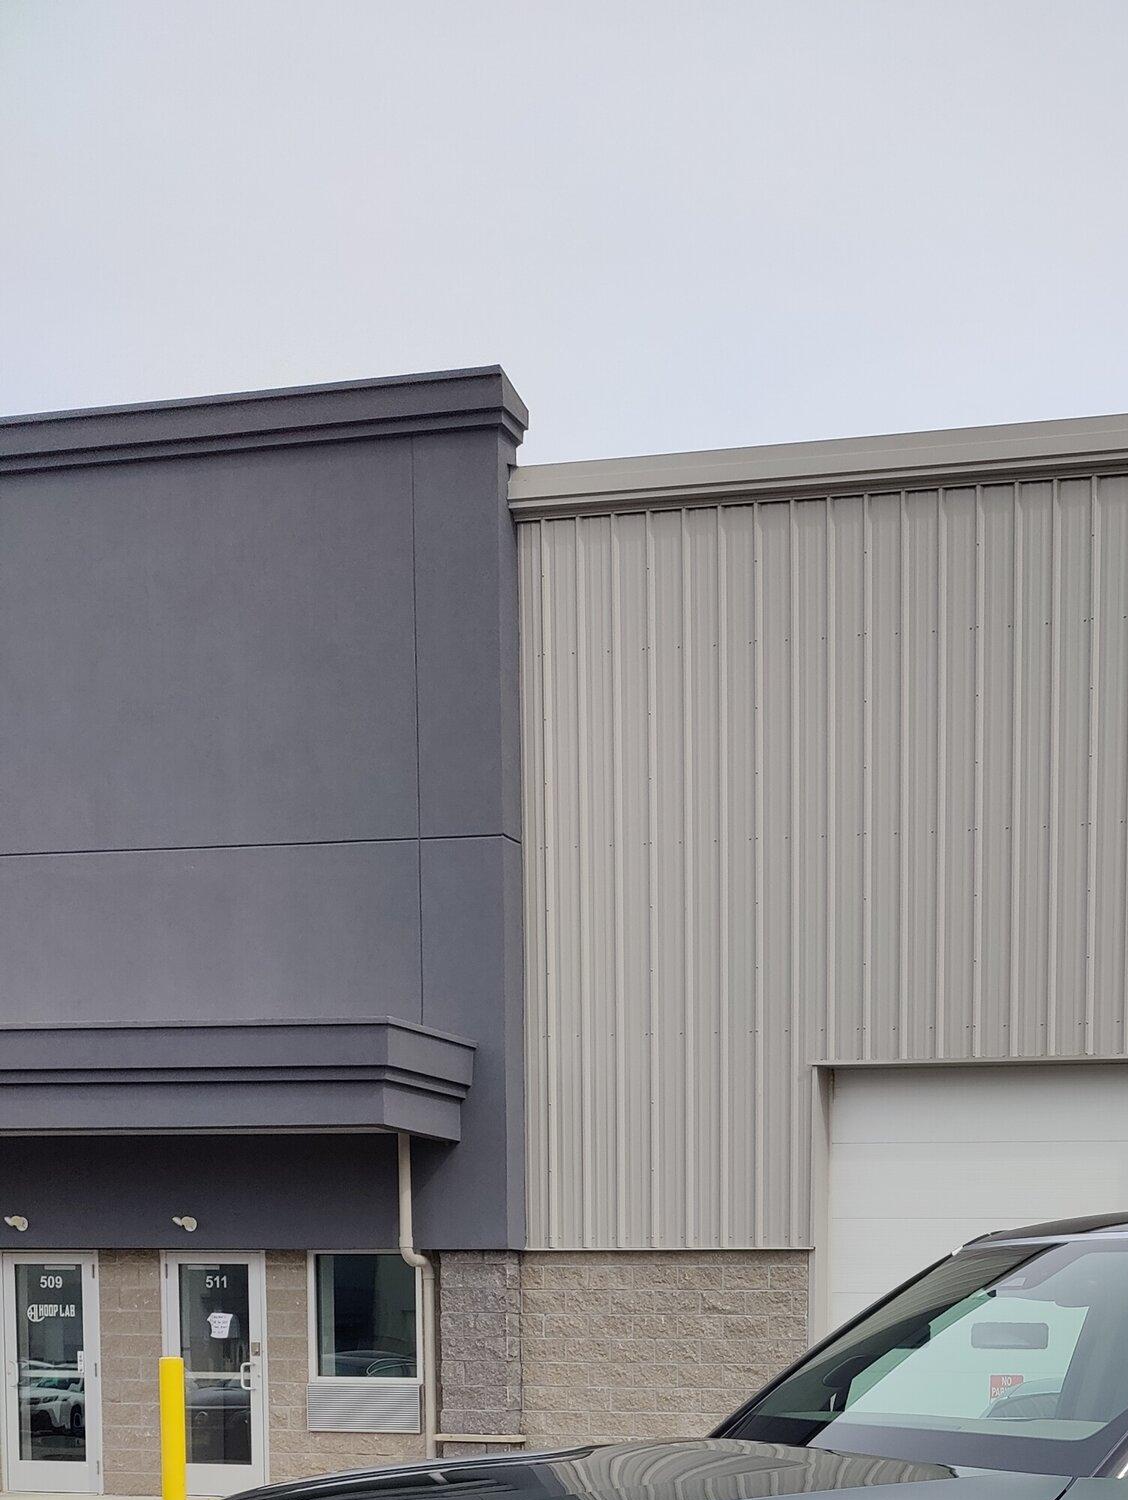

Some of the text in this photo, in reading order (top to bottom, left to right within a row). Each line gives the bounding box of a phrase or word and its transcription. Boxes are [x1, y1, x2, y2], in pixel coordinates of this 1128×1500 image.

[40, 1275, 63, 1289] 509
[205, 1275, 227, 1288] 511
[39, 1304, 58, 1317] HOOP
[59, 1304, 76, 1317] LAB
[1001, 1375, 1012, 1386] NO
